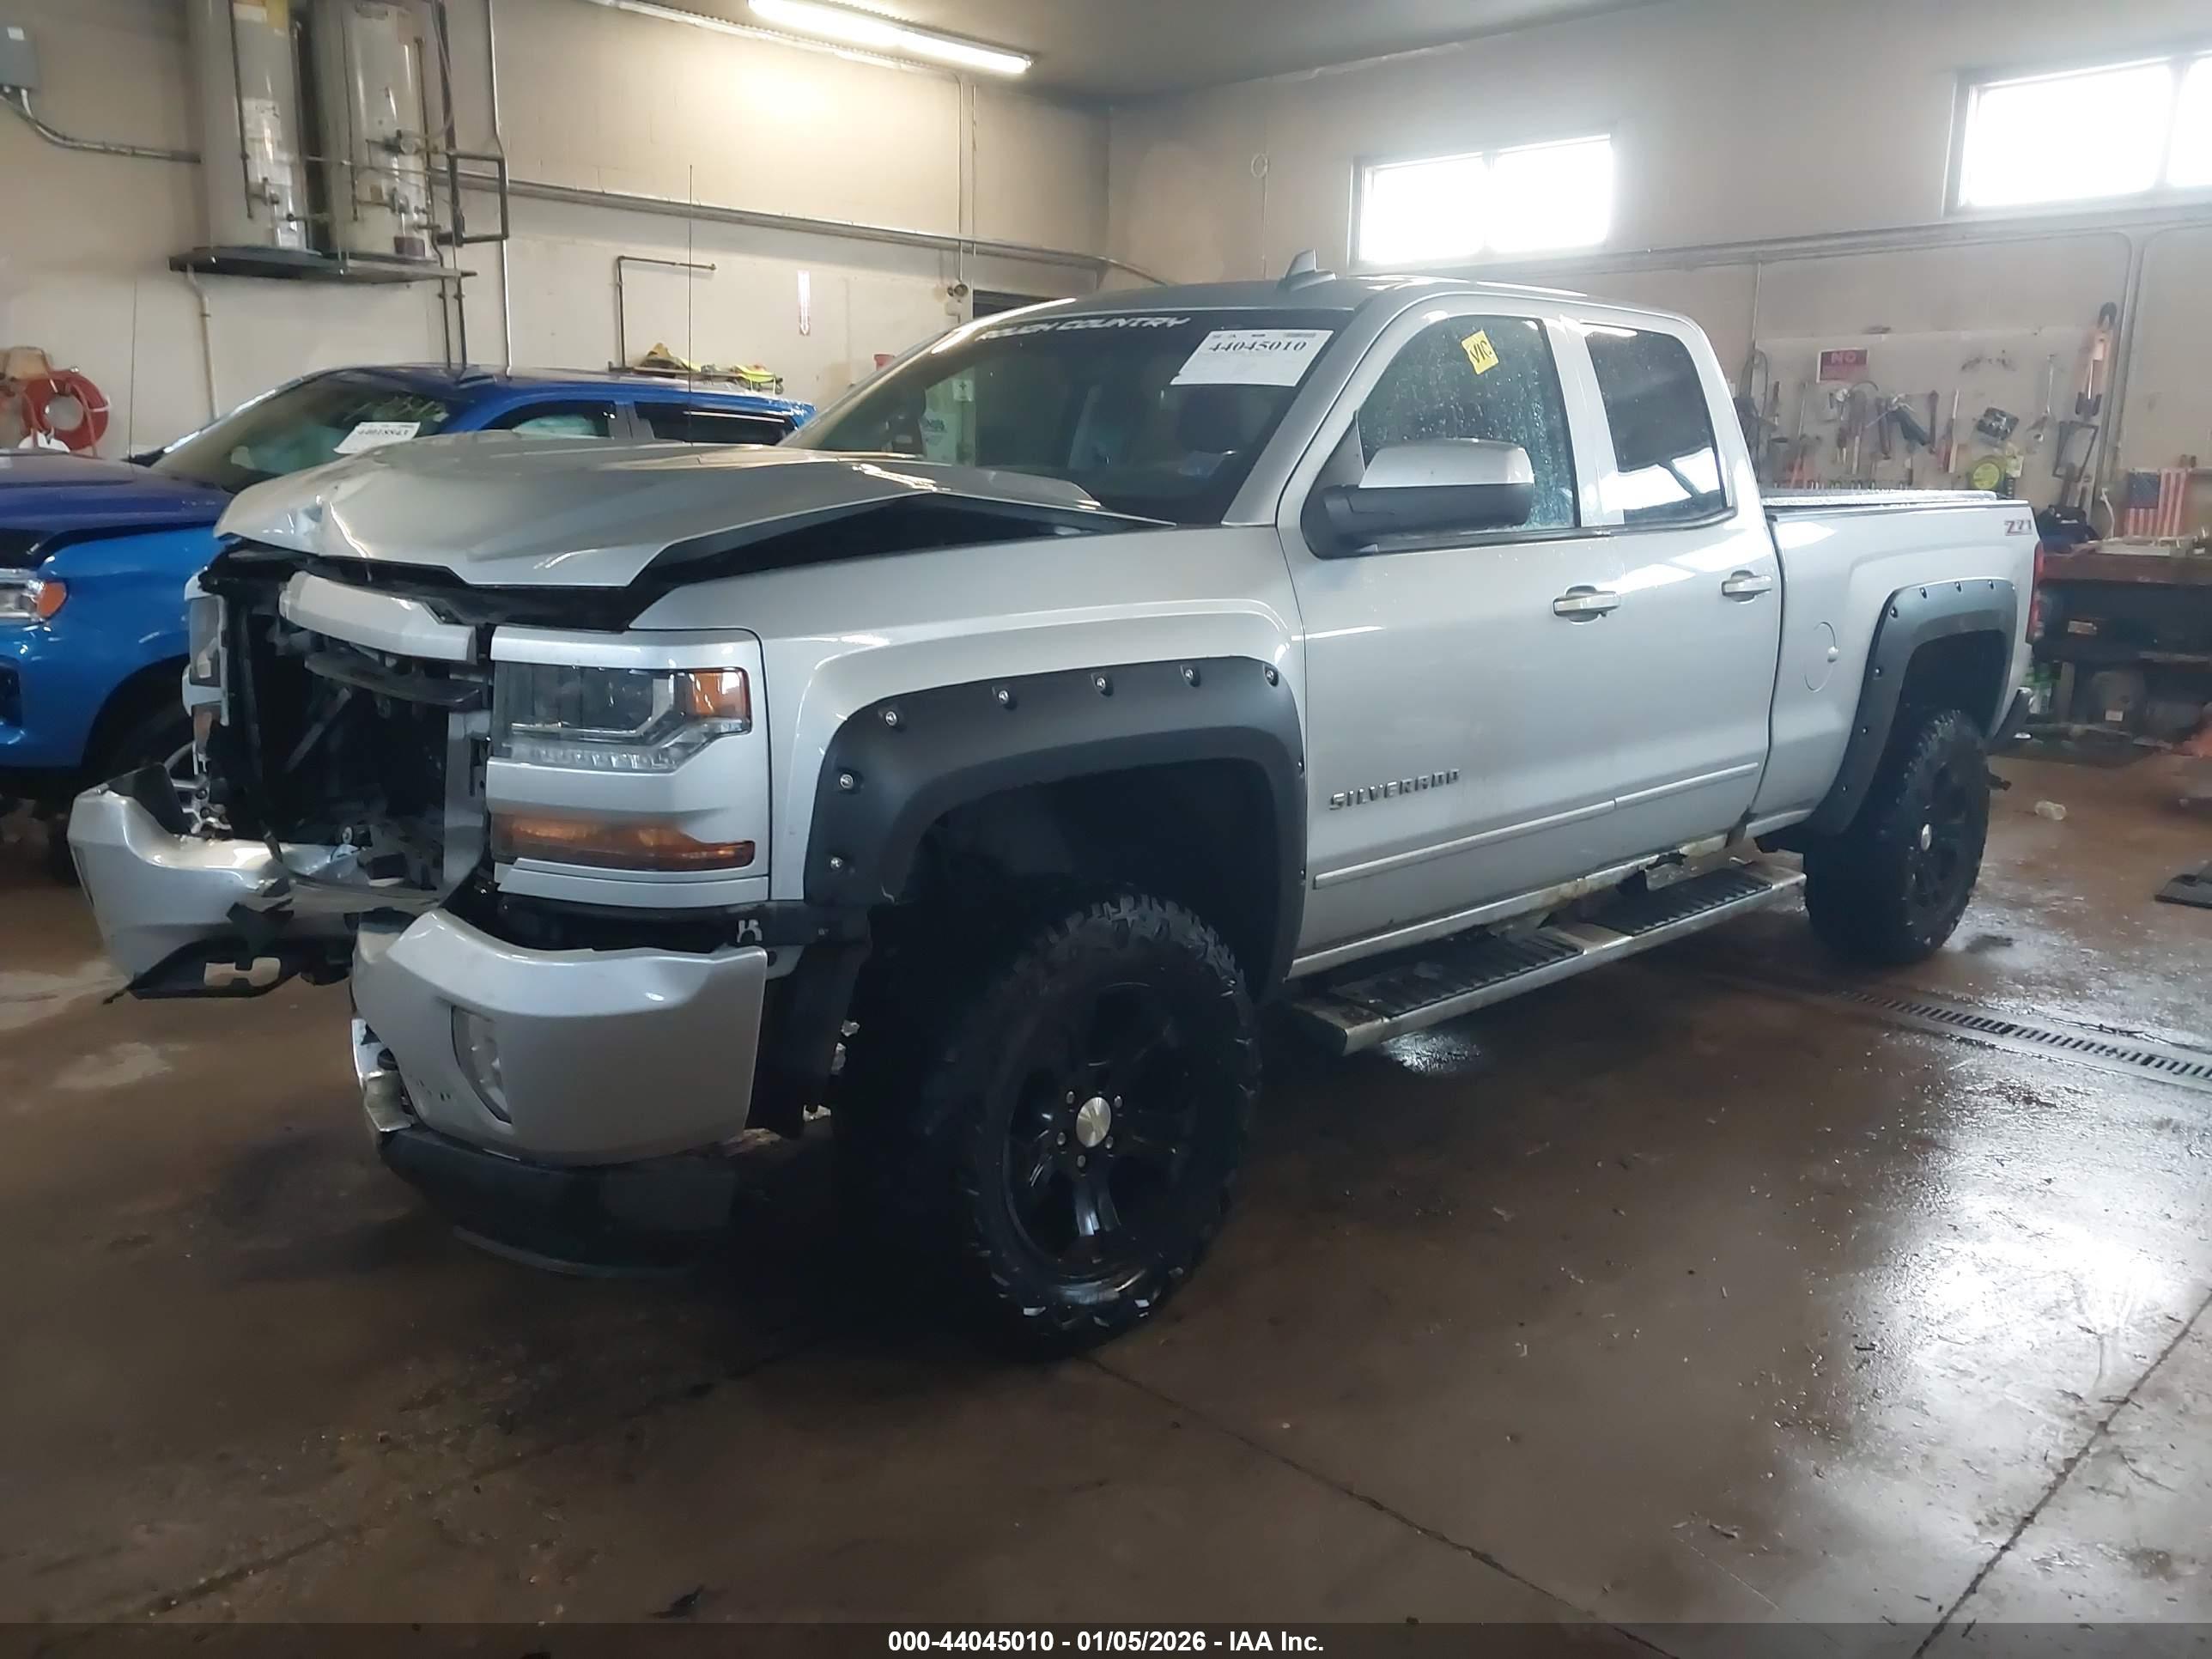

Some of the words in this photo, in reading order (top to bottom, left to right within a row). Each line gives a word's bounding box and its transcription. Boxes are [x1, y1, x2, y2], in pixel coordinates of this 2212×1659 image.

[1056, 316, 1192, 331] COUNTRY
[1209, 341, 1307, 352] 44045010
[2004, 519, 2033, 537] Z71
[1328, 769, 1460, 811] SILVERADO
